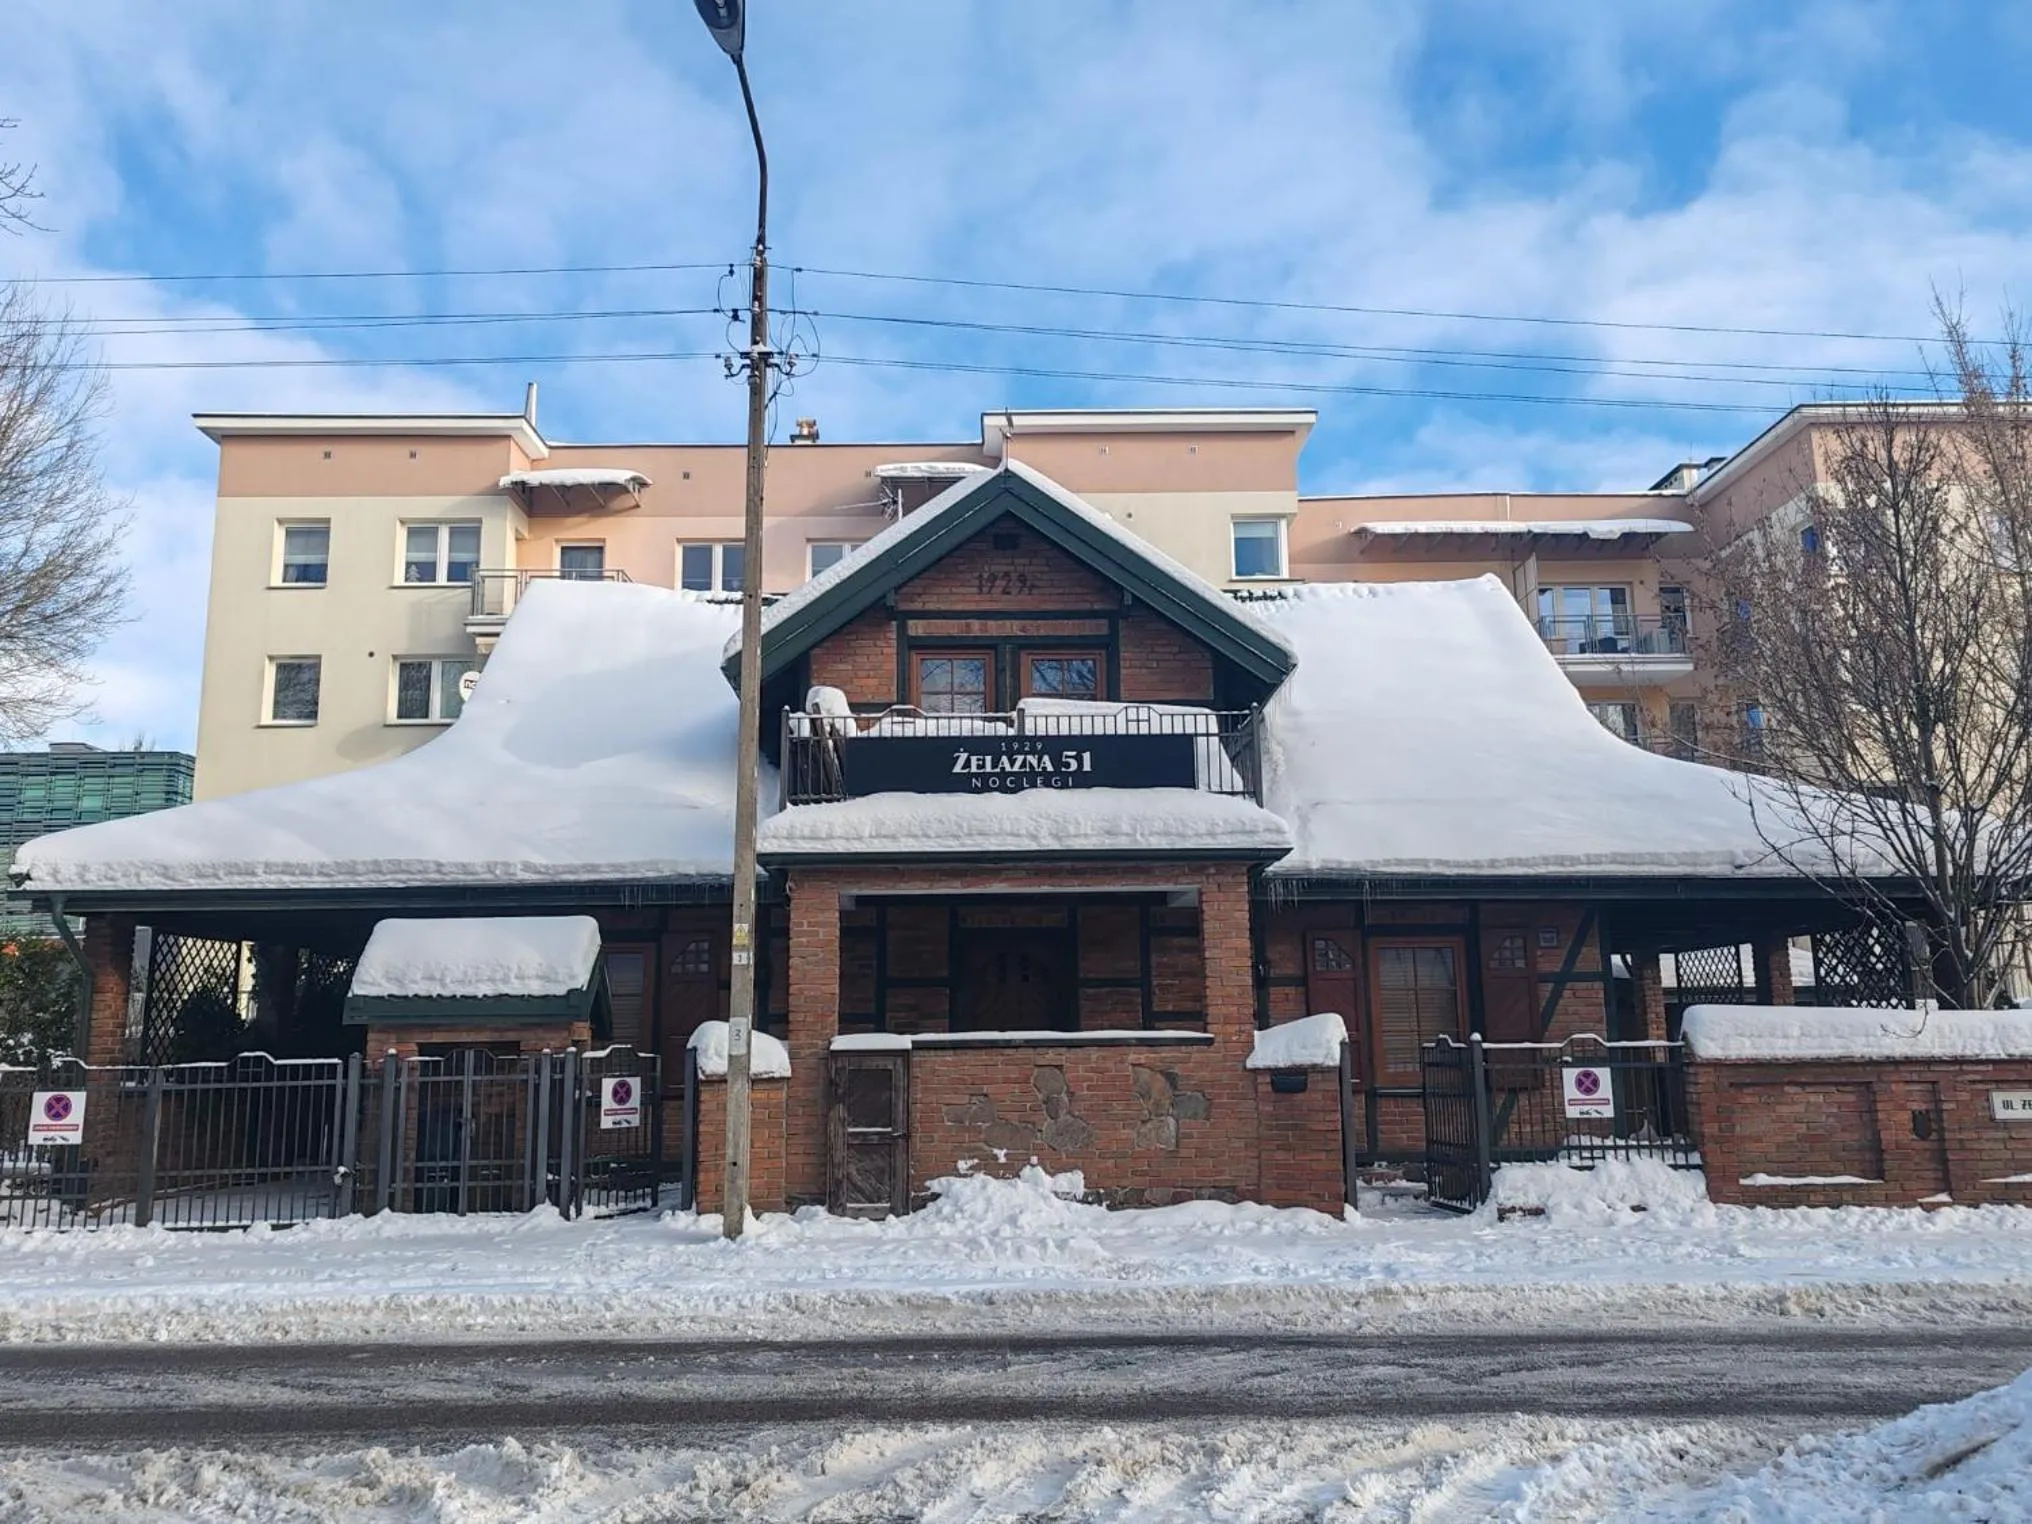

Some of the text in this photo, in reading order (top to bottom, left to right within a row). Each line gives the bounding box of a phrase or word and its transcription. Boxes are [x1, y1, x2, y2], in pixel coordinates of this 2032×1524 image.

[1001, 742, 1043, 751] 1929
[952, 747, 1092, 773] ŻELAZNA 51
[972, 776, 1073, 788] NOCLEGI
